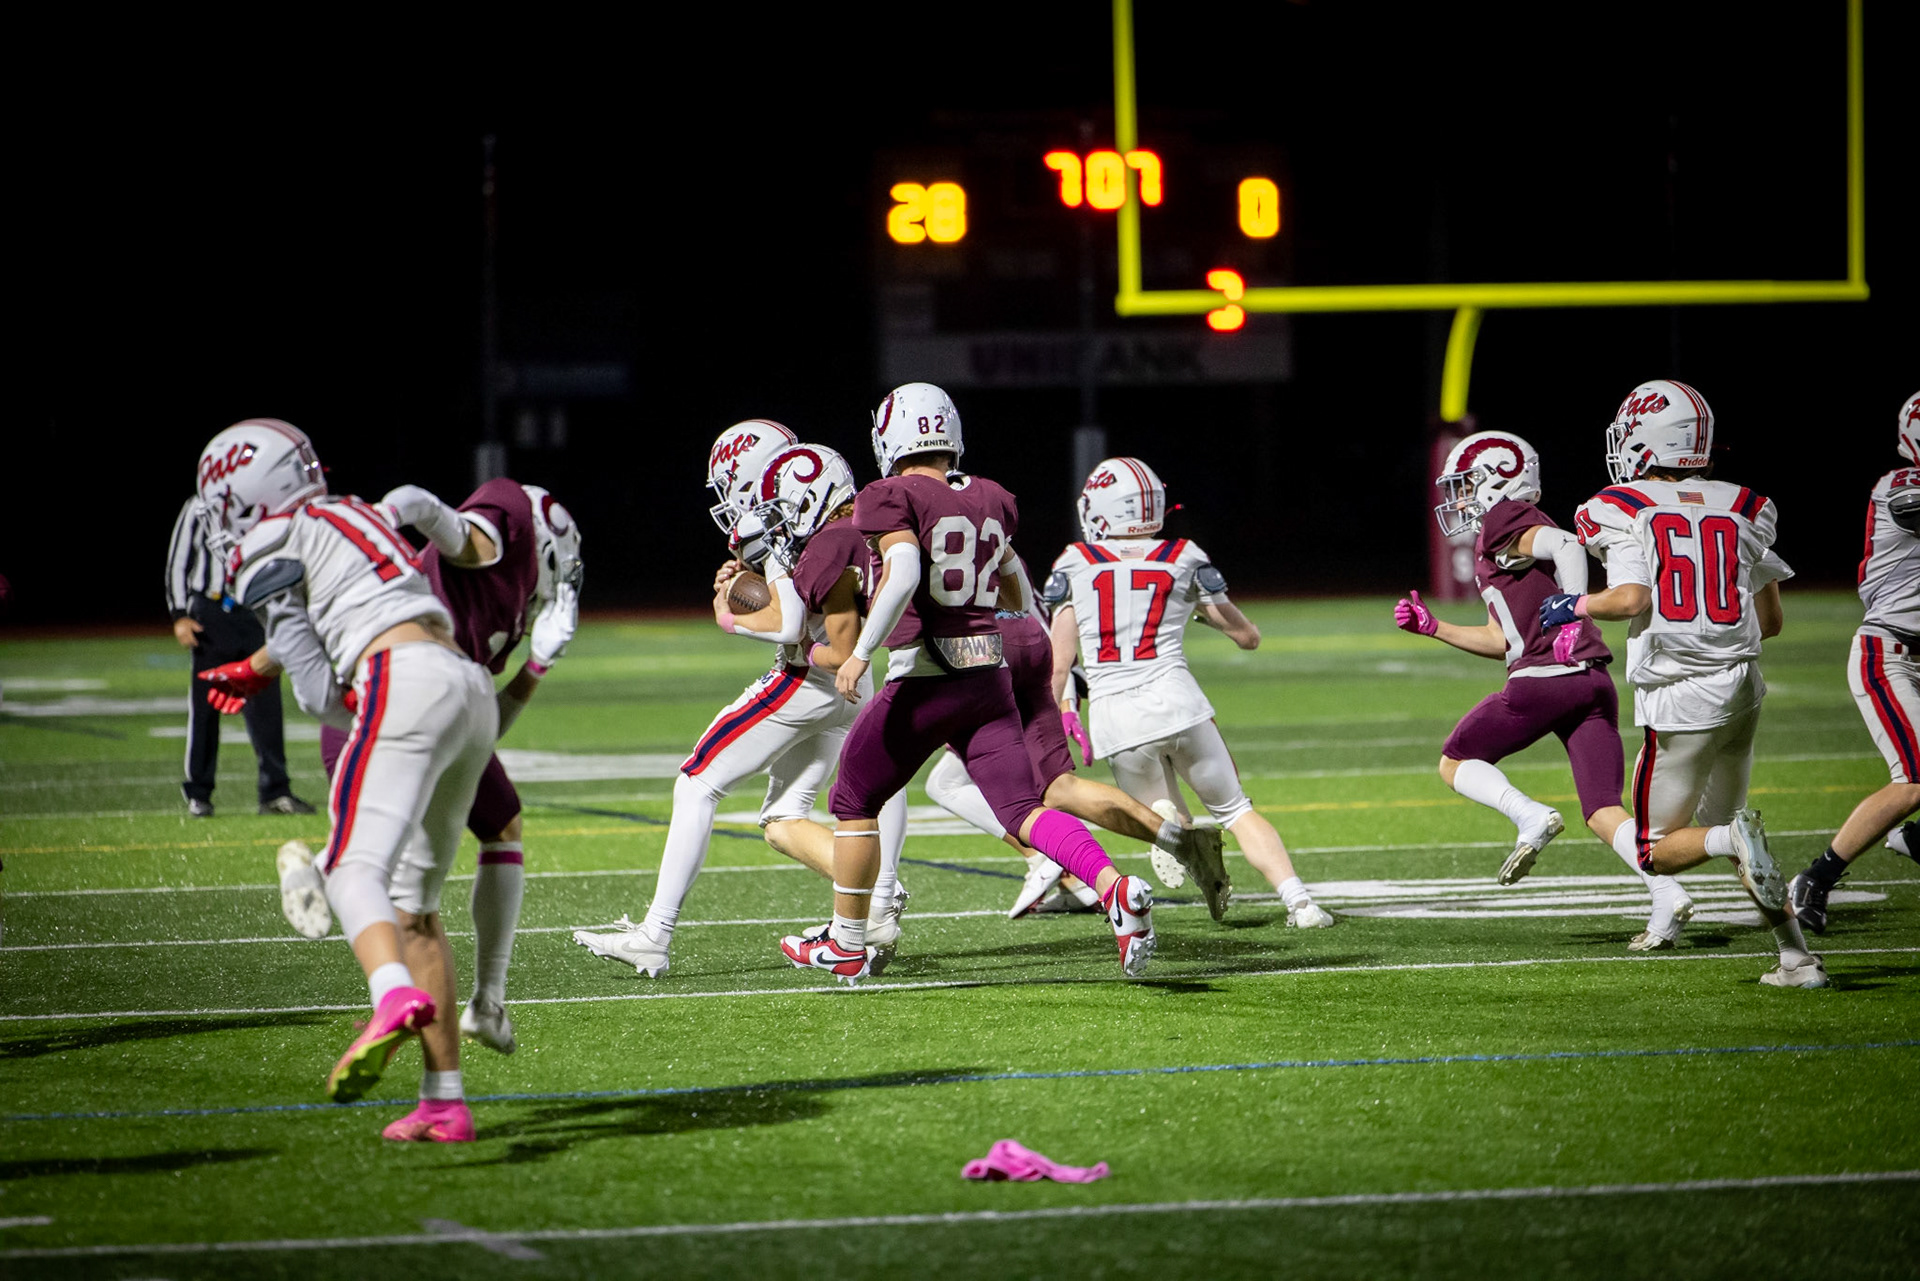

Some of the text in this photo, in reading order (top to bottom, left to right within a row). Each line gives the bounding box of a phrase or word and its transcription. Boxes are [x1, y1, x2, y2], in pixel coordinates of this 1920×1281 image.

[1238, 176, 1280, 239] 0
[711, 433, 760, 469] Pats
[916, 439, 949, 448] XENITH
[917, 415, 945, 435] 82
[200, 443, 257, 490] Pats
[929, 515, 1007, 608] 82
[1650, 512, 1742, 626] 60
[1092, 569, 1175, 664] 17
